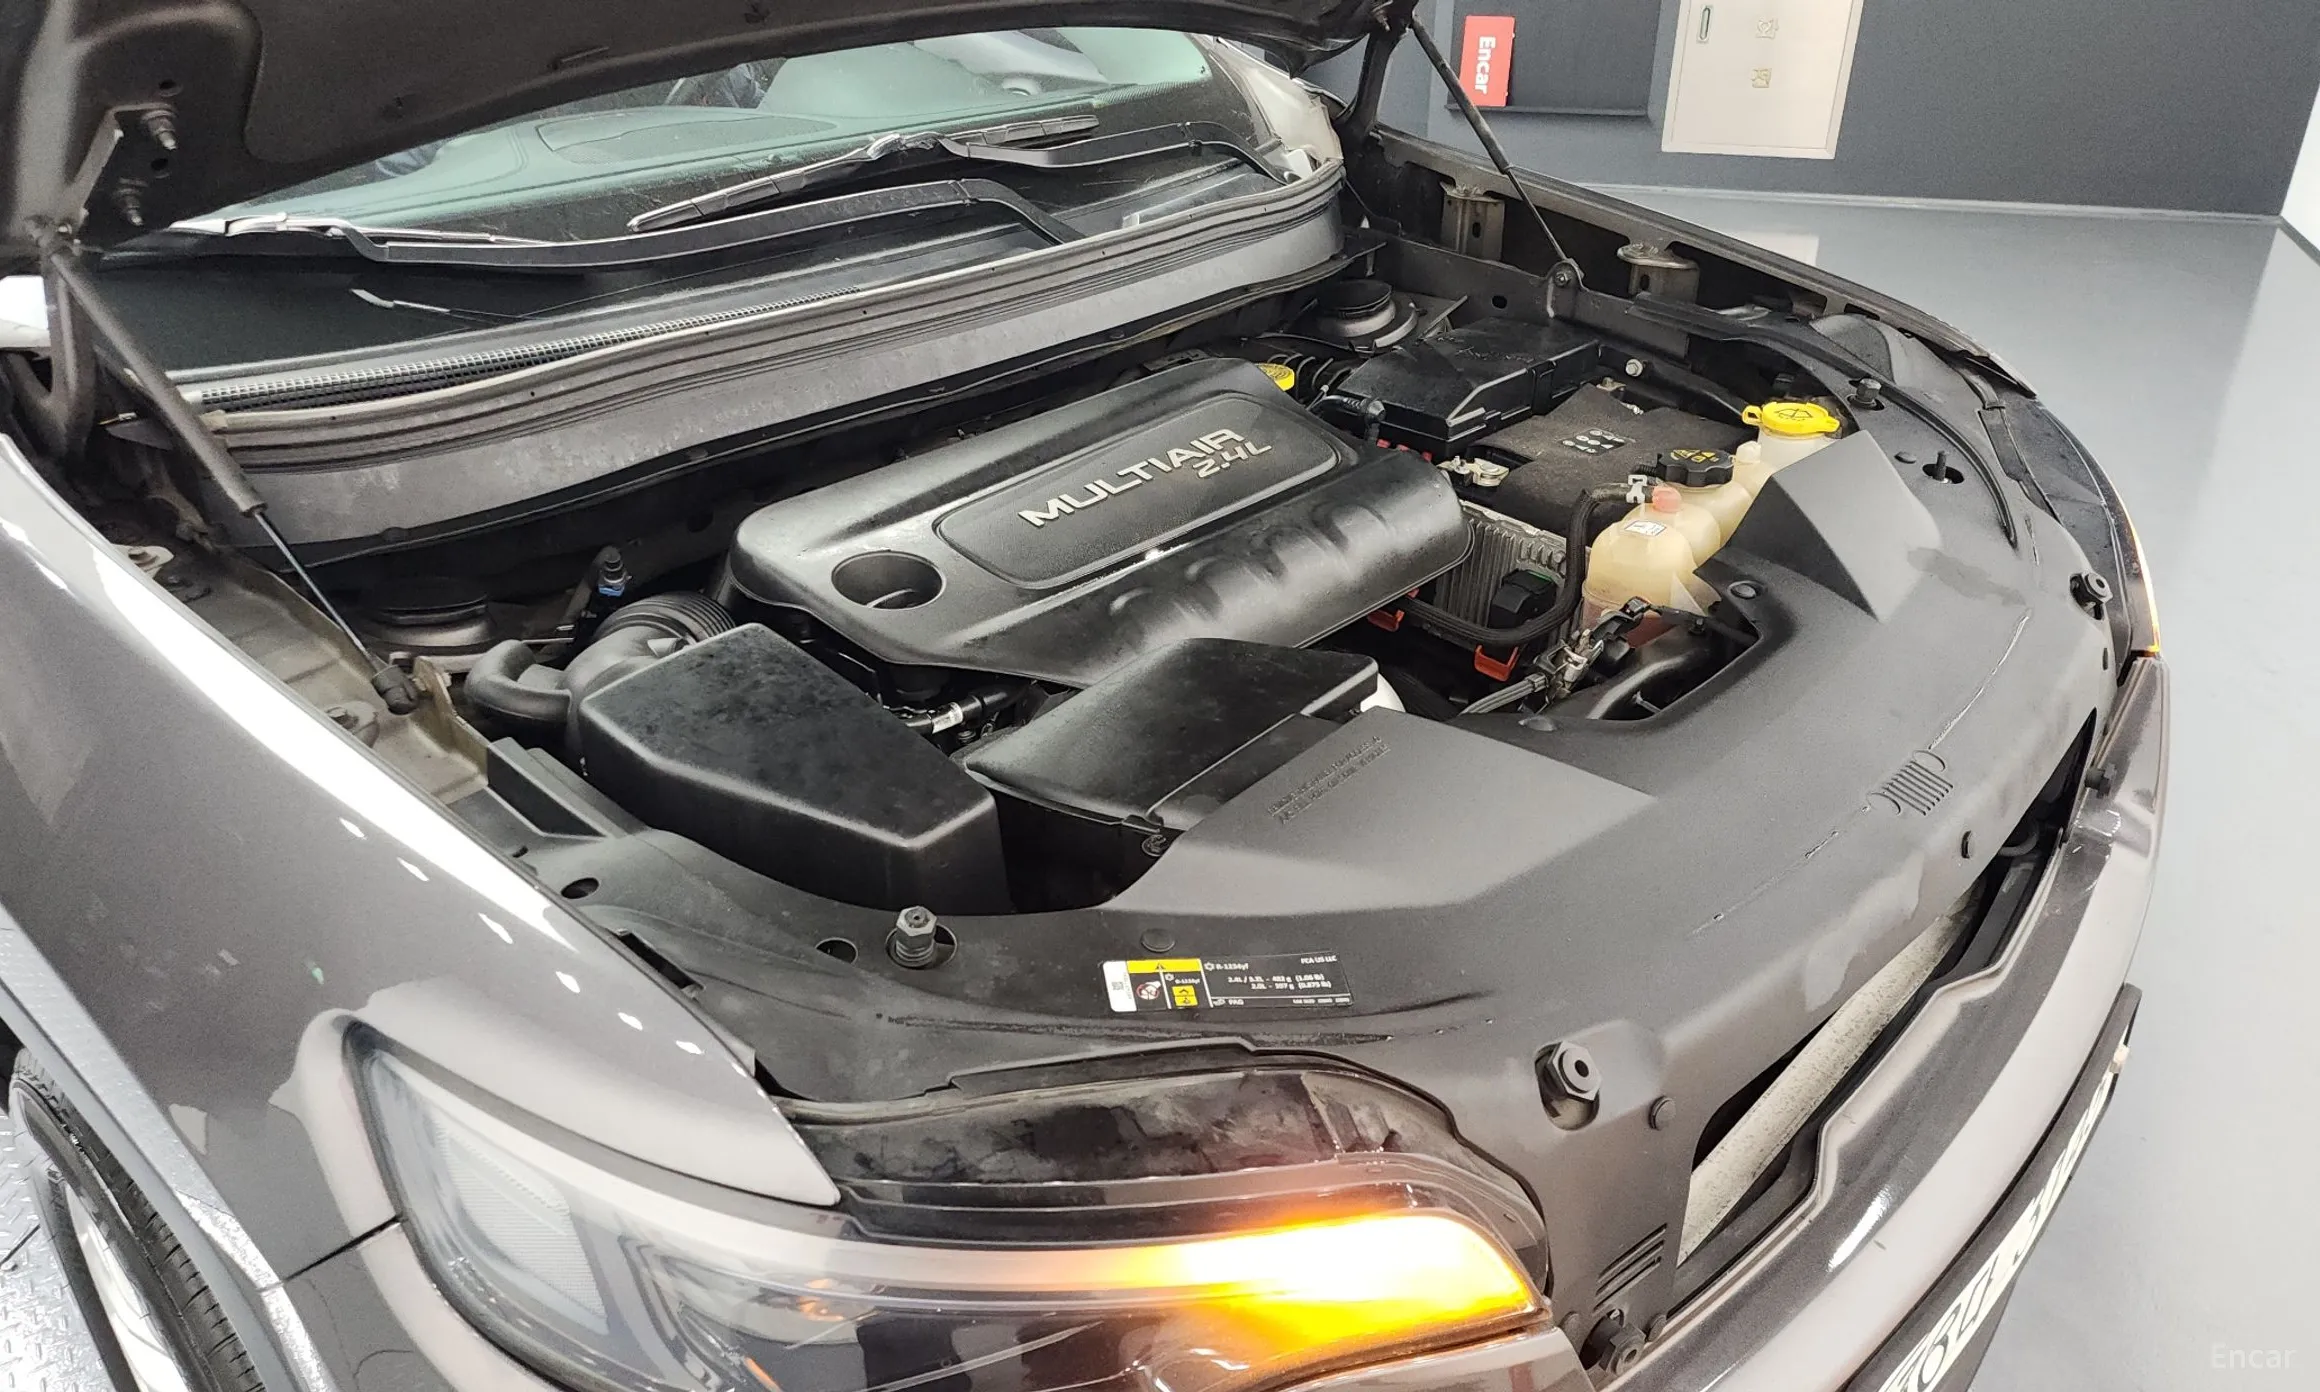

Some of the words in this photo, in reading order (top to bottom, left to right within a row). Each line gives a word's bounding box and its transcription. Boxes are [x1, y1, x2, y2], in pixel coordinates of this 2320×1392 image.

[1475, 36, 1496, 95] Encar
[1018, 428, 1245, 527] MULTIAIR
[1192, 440, 1272, 478] 2.4L
